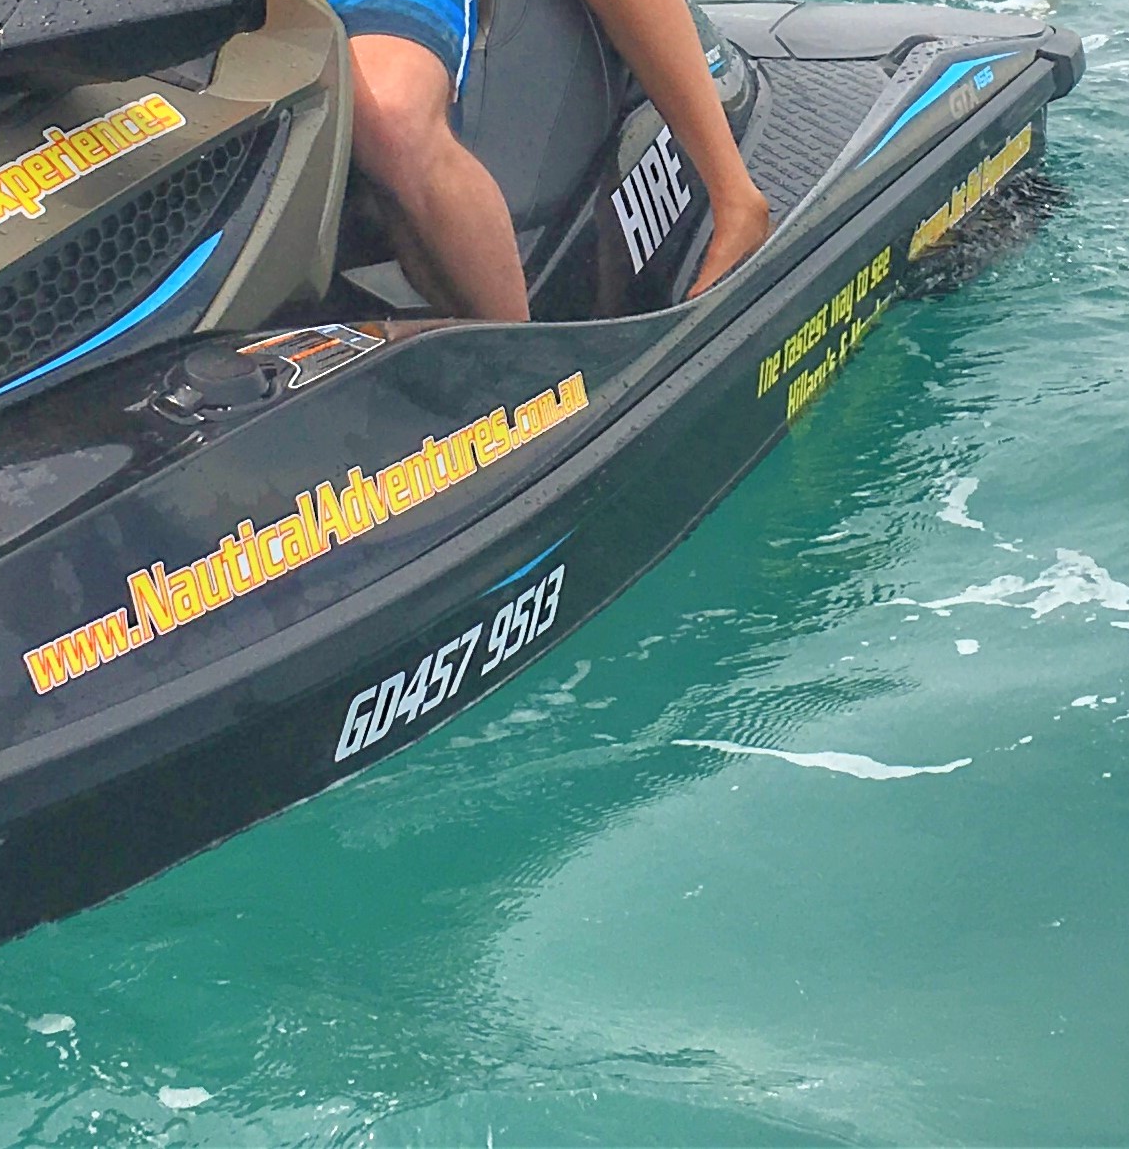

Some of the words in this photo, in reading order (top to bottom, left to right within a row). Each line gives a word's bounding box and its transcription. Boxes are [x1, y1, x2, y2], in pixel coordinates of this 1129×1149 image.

[611, 125, 691, 275] HIRE
[783, 304, 829, 373] fastest
[831, 280, 855, 327] way
[857, 266, 869, 302] to
[871, 246, 891, 289] see
[23, 371, 588, 694] www.NauticalAdventures.com.au
[481, 564, 565, 676] 9513
